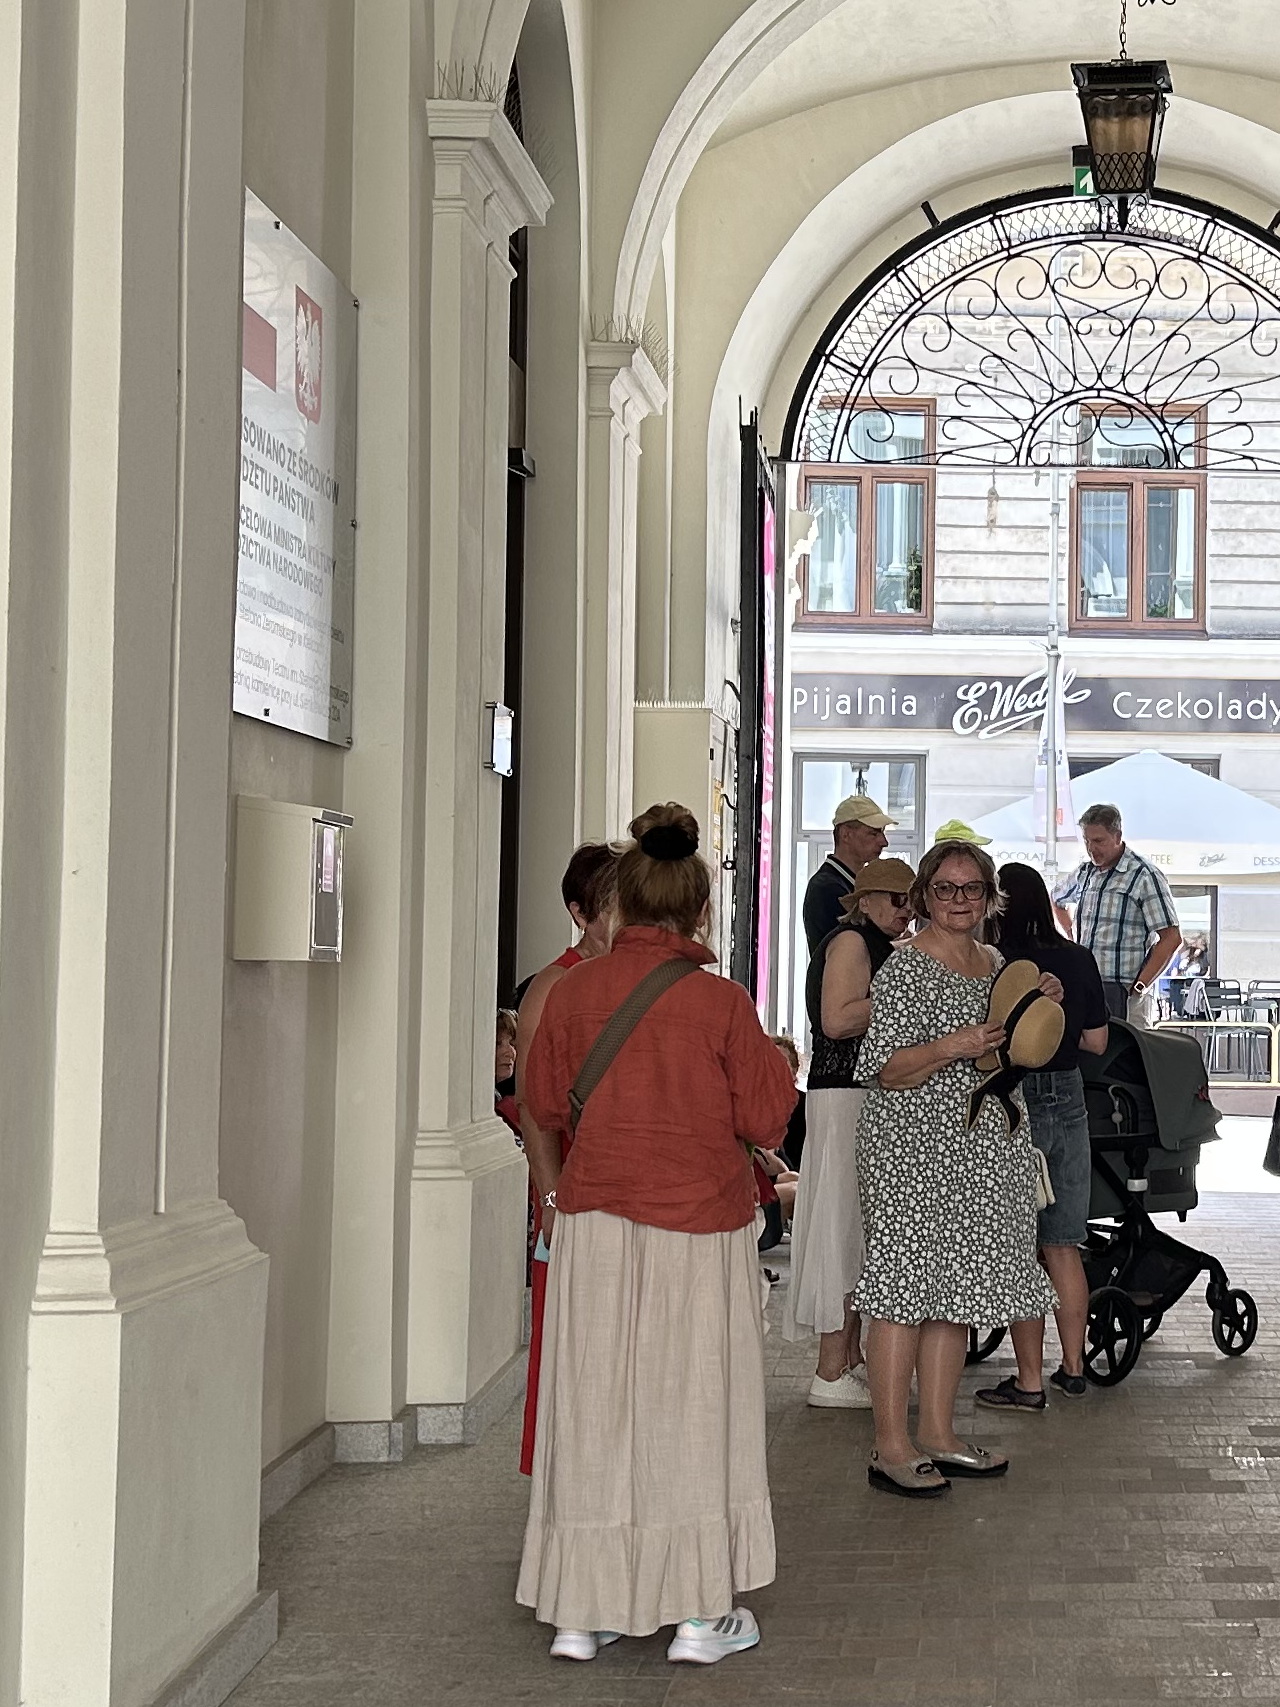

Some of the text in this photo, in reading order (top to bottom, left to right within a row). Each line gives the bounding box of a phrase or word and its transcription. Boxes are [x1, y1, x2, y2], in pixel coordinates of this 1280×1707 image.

[272, 477, 315, 526] PAŃSTWA
[287, 447, 297, 477] ZE
[298, 448, 340, 506] ŚRODKÓW
[240, 503, 272, 542] CELOWA
[273, 523, 307, 562] MINISTRA
[272, 552, 324, 597] NARODOWEGO
[793, 687, 917, 720] Pijalnia
[952, 667, 1092, 740] E.Wedl
